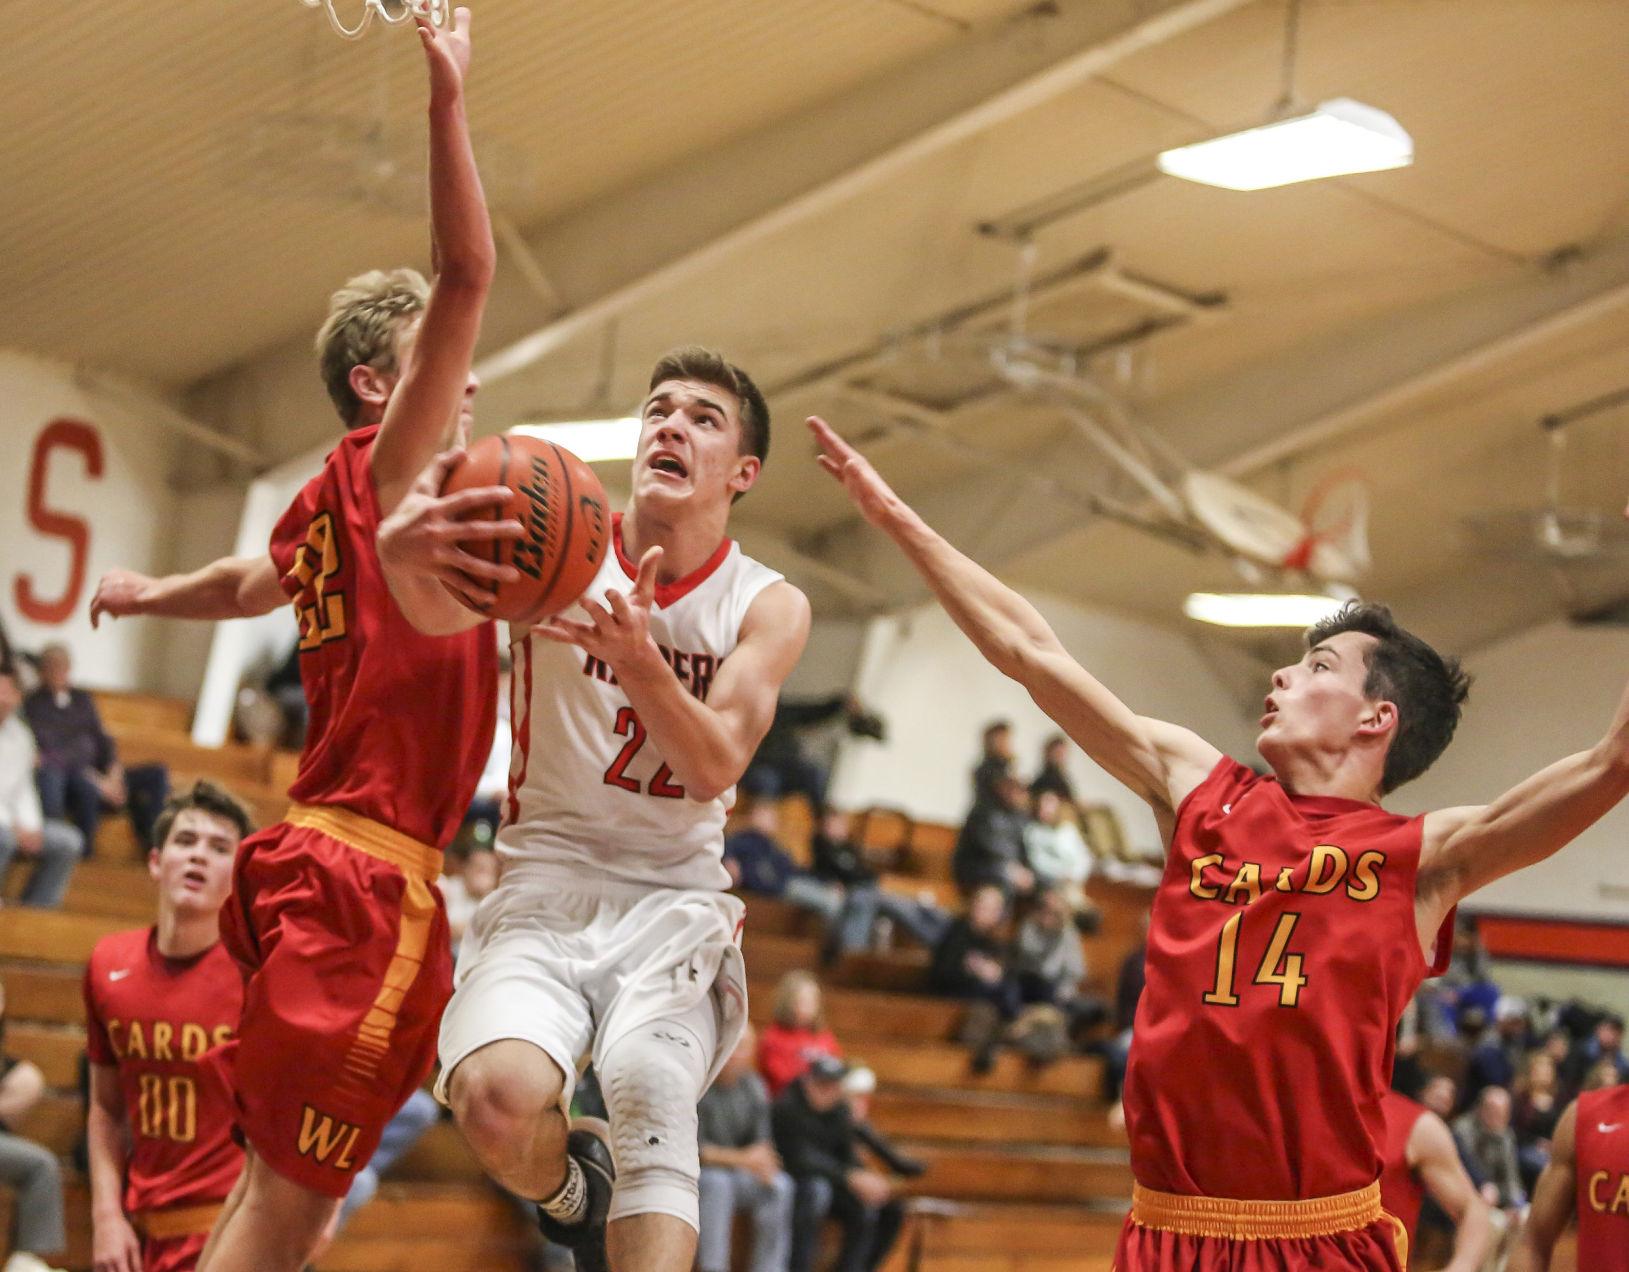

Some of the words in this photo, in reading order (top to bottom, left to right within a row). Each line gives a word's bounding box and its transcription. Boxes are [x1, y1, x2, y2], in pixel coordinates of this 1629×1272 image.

[1202, 911, 1308, 1007] 14
[139, 1074, 197, 1141] 00
[297, 1103, 361, 1170] WL
